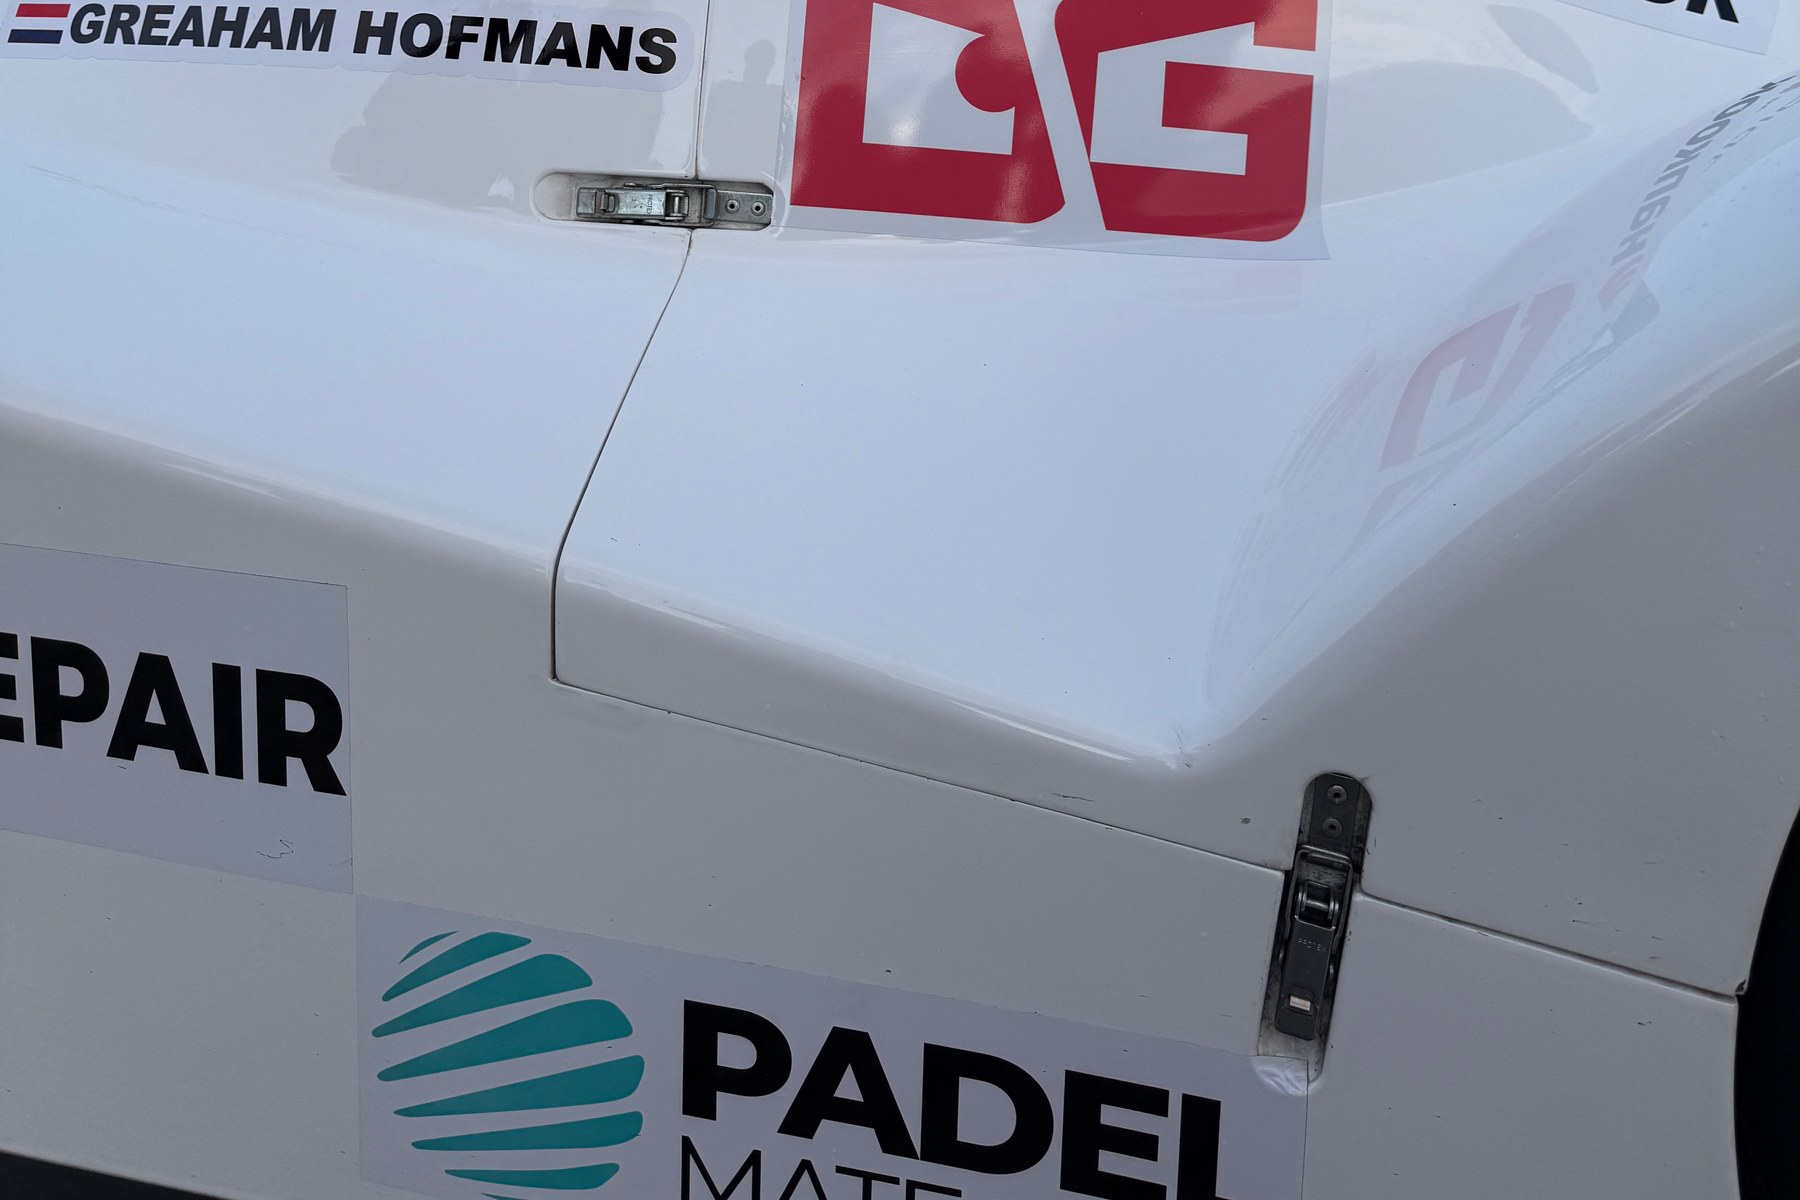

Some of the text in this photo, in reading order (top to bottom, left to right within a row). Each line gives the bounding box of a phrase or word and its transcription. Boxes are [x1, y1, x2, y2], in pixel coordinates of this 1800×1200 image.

[69, 2, 678, 75] GREAHAM HOFMANS
[682, 999, 1222, 1200] PADEL
